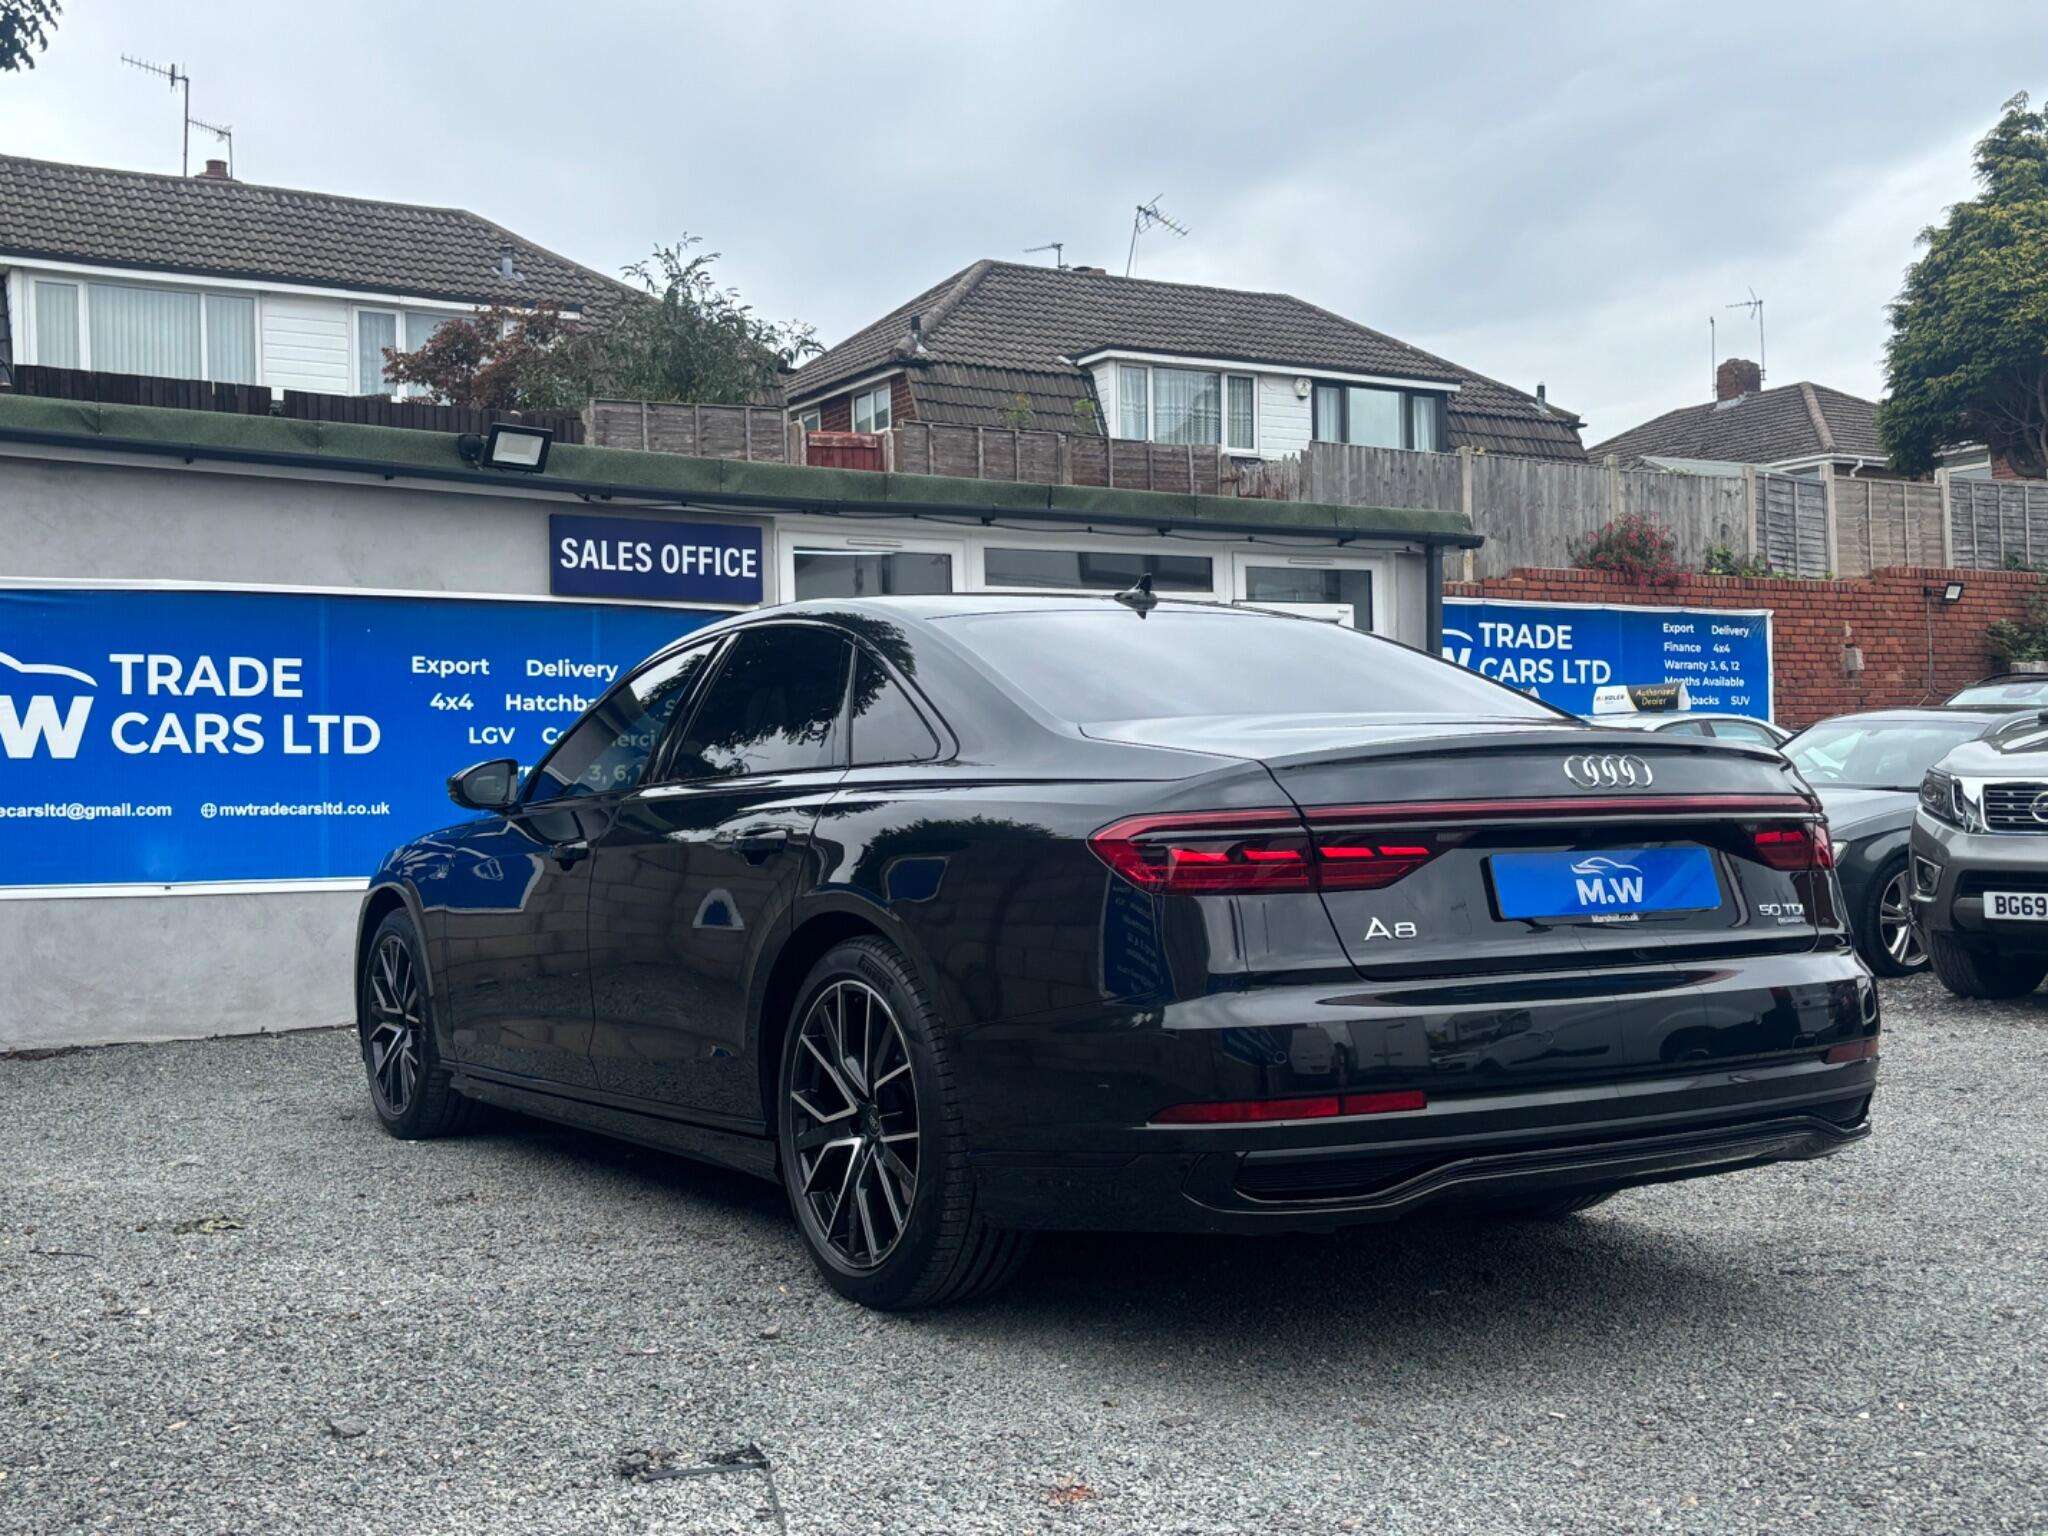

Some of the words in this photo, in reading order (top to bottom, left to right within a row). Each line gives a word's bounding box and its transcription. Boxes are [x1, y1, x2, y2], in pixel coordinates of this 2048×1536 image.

[560, 537, 653, 574] SALES
[661, 544, 757, 579] OFFICE
[1478, 621, 1573, 650] TRADE
[1663, 622, 1694, 635] Export
[1711, 624, 1749, 638] Delivery
[1664, 641, 1701, 652] Finance
[1713, 643, 1731, 653] 4x4
[109, 653, 303, 698] TRADE
[411, 656, 490, 679] Export
[526, 658, 618, 682] Delivery
[1480, 657, 1555, 684] CARS
[1562, 659, 1612, 684] LTD
[1664, 659, 1708, 672] Warranty
[1710, 660, 1718, 671] 3,
[1720, 661, 1729, 672] 6,
[1731, 661, 1740, 671] 12
[1702, 677, 1745, 687] Available
[430, 692, 474, 711] 4x4
[1731, 696, 1750, 706] SUV
[111, 712, 265, 754] CARS
[283, 714, 381, 755] LTD
[468, 726, 516, 745] LGV
[1576, 876, 1643, 906] M.W
[1759, 903, 1781, 916] 50
[1994, 895, 2047, 917] BG69
[1364, 916, 1418, 941] A8
